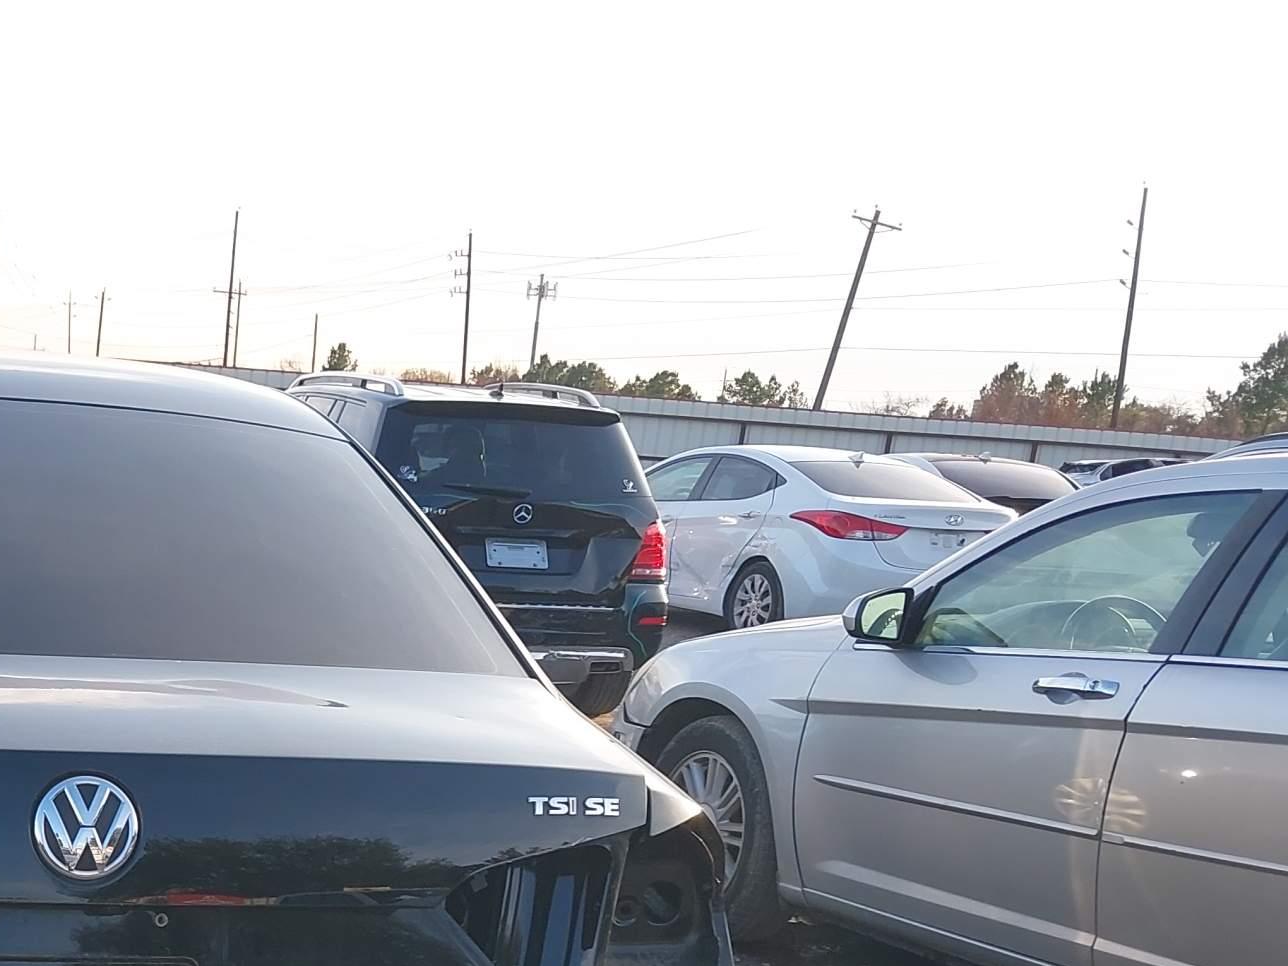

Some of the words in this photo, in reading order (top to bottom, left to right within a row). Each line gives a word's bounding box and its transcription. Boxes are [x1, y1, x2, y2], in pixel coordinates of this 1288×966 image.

[34, 775, 139, 881] VW
[527, 796, 577, 816] TSI
[584, 797, 620, 817] SE
